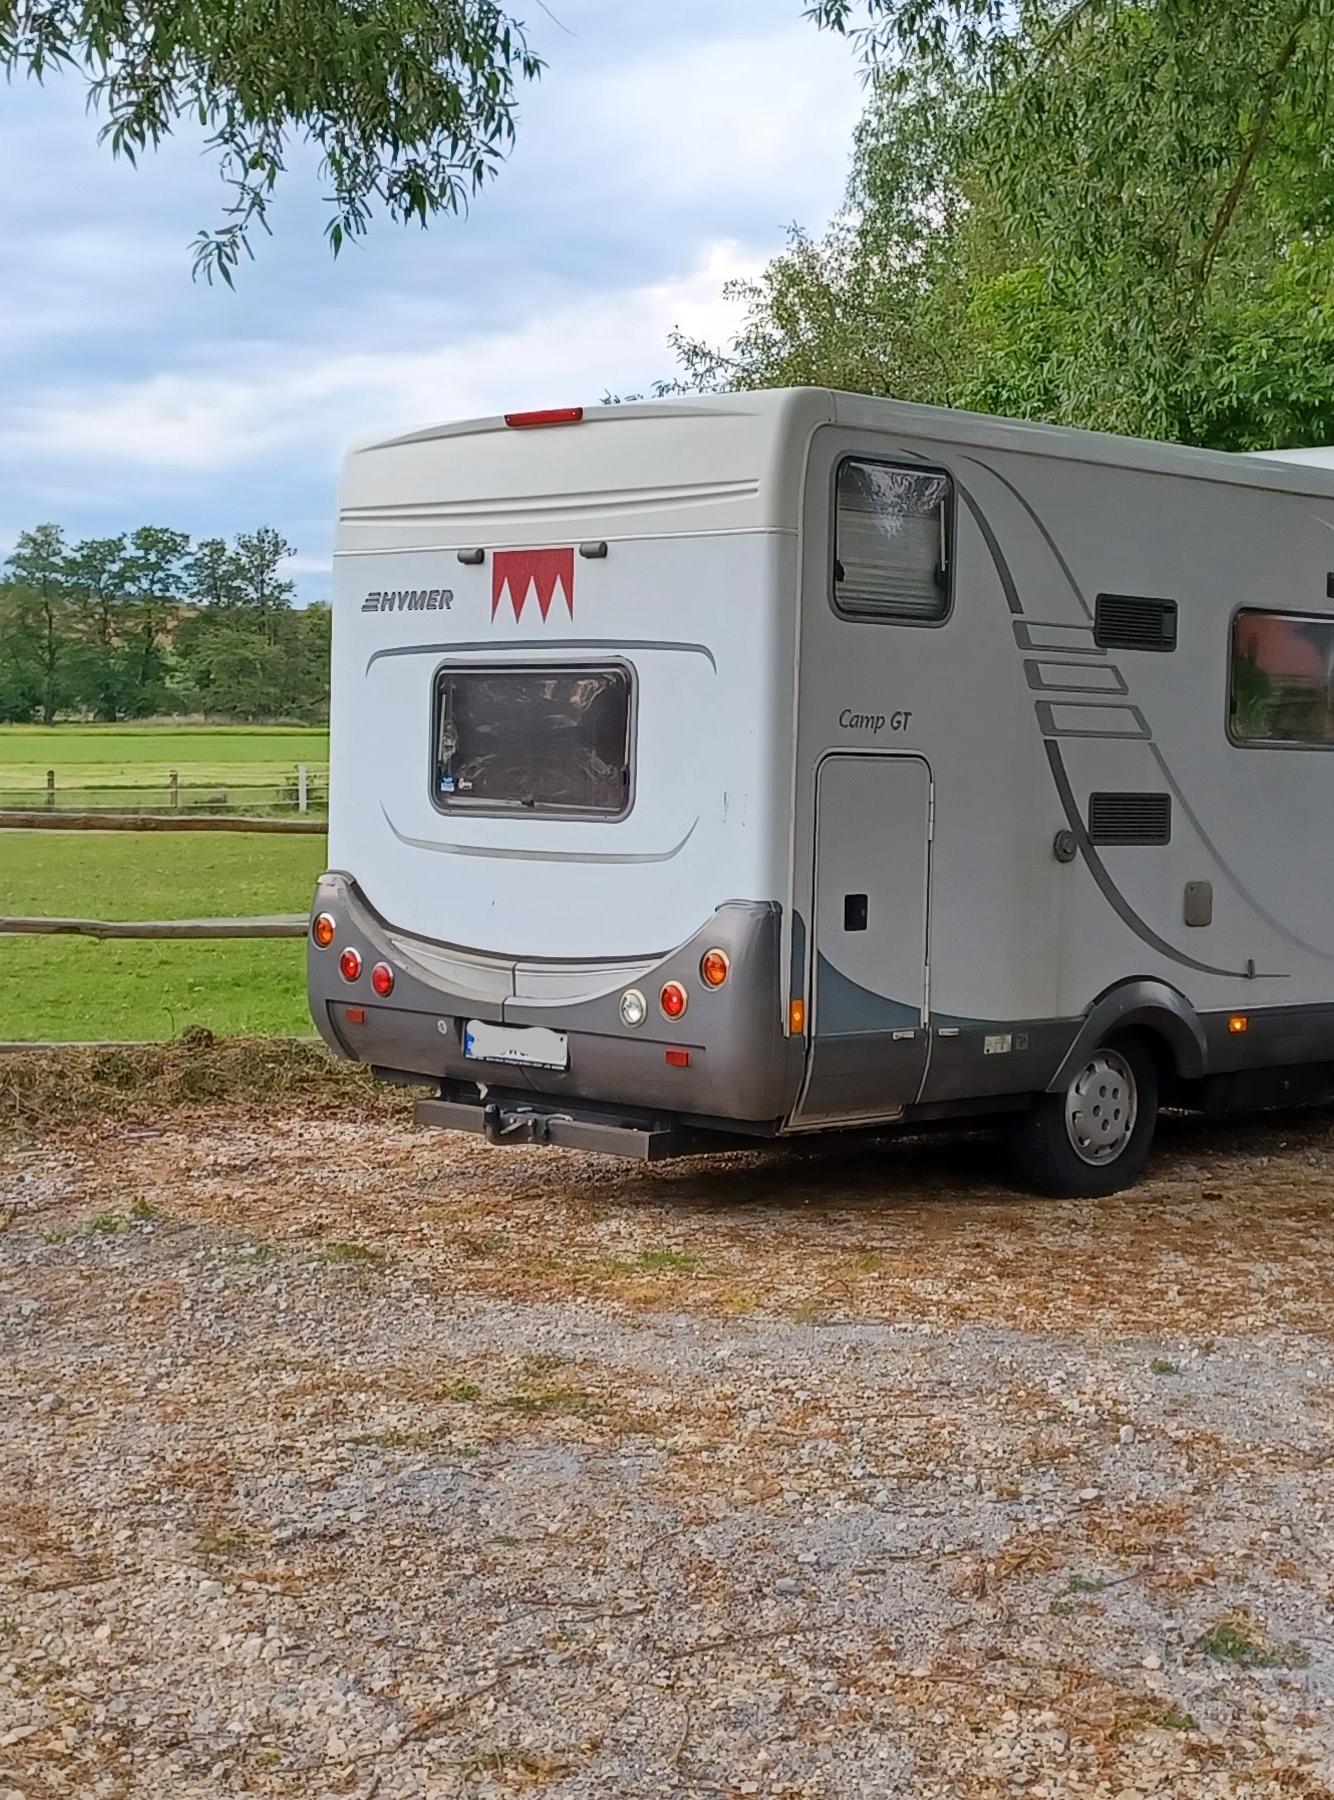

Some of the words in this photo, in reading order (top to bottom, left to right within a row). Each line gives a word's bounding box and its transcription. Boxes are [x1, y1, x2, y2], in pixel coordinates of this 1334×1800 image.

[380, 589, 454, 612] HYMER
[839, 708, 886, 734] Camp
[890, 711, 913, 731] GT
